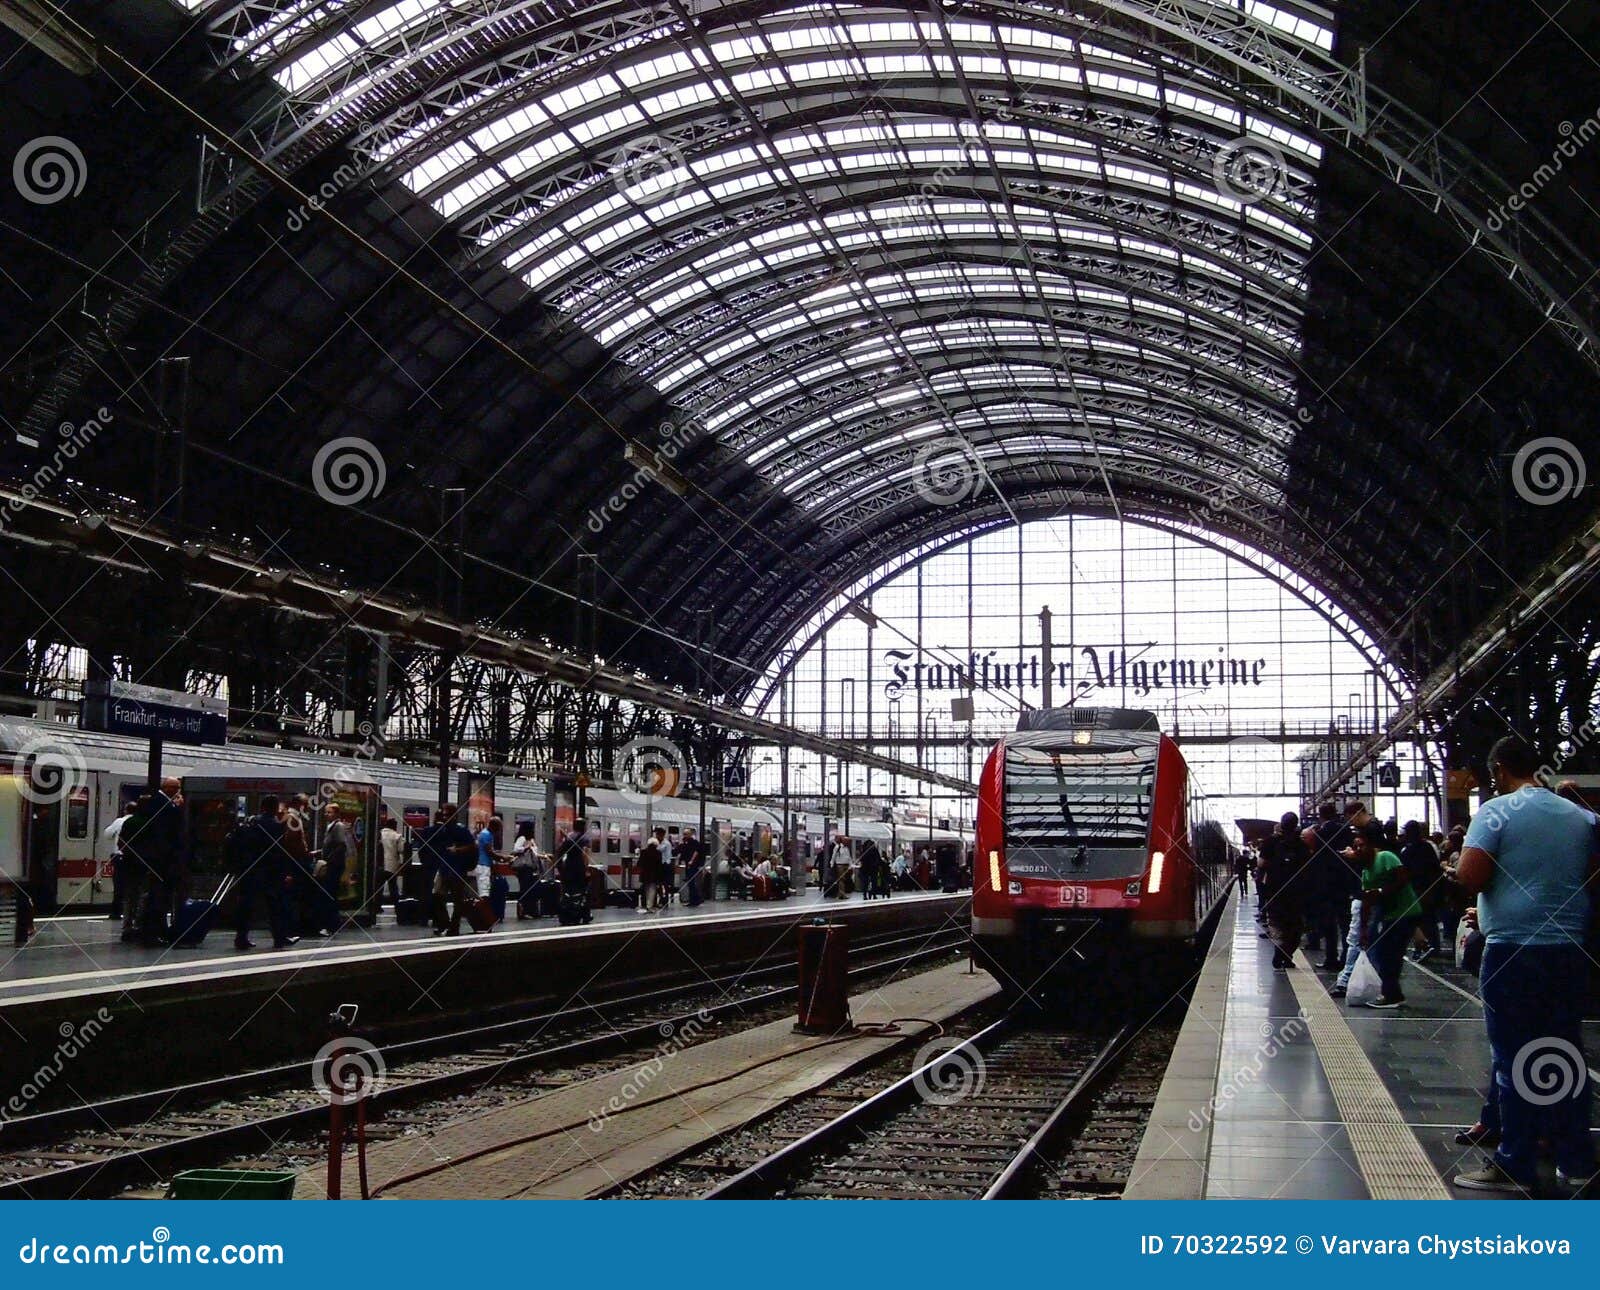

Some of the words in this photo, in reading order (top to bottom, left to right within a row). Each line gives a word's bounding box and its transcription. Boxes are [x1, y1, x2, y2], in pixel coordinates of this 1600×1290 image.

[884, 650, 1071, 699] Frankfurtr
[1076, 646, 1266, 697] Allgemeine
[115, 705, 156, 727] Frankfurt
[729, 767, 741, 783] A
[1382, 766, 1395, 783] A
[1061, 886, 1086, 903] DB
